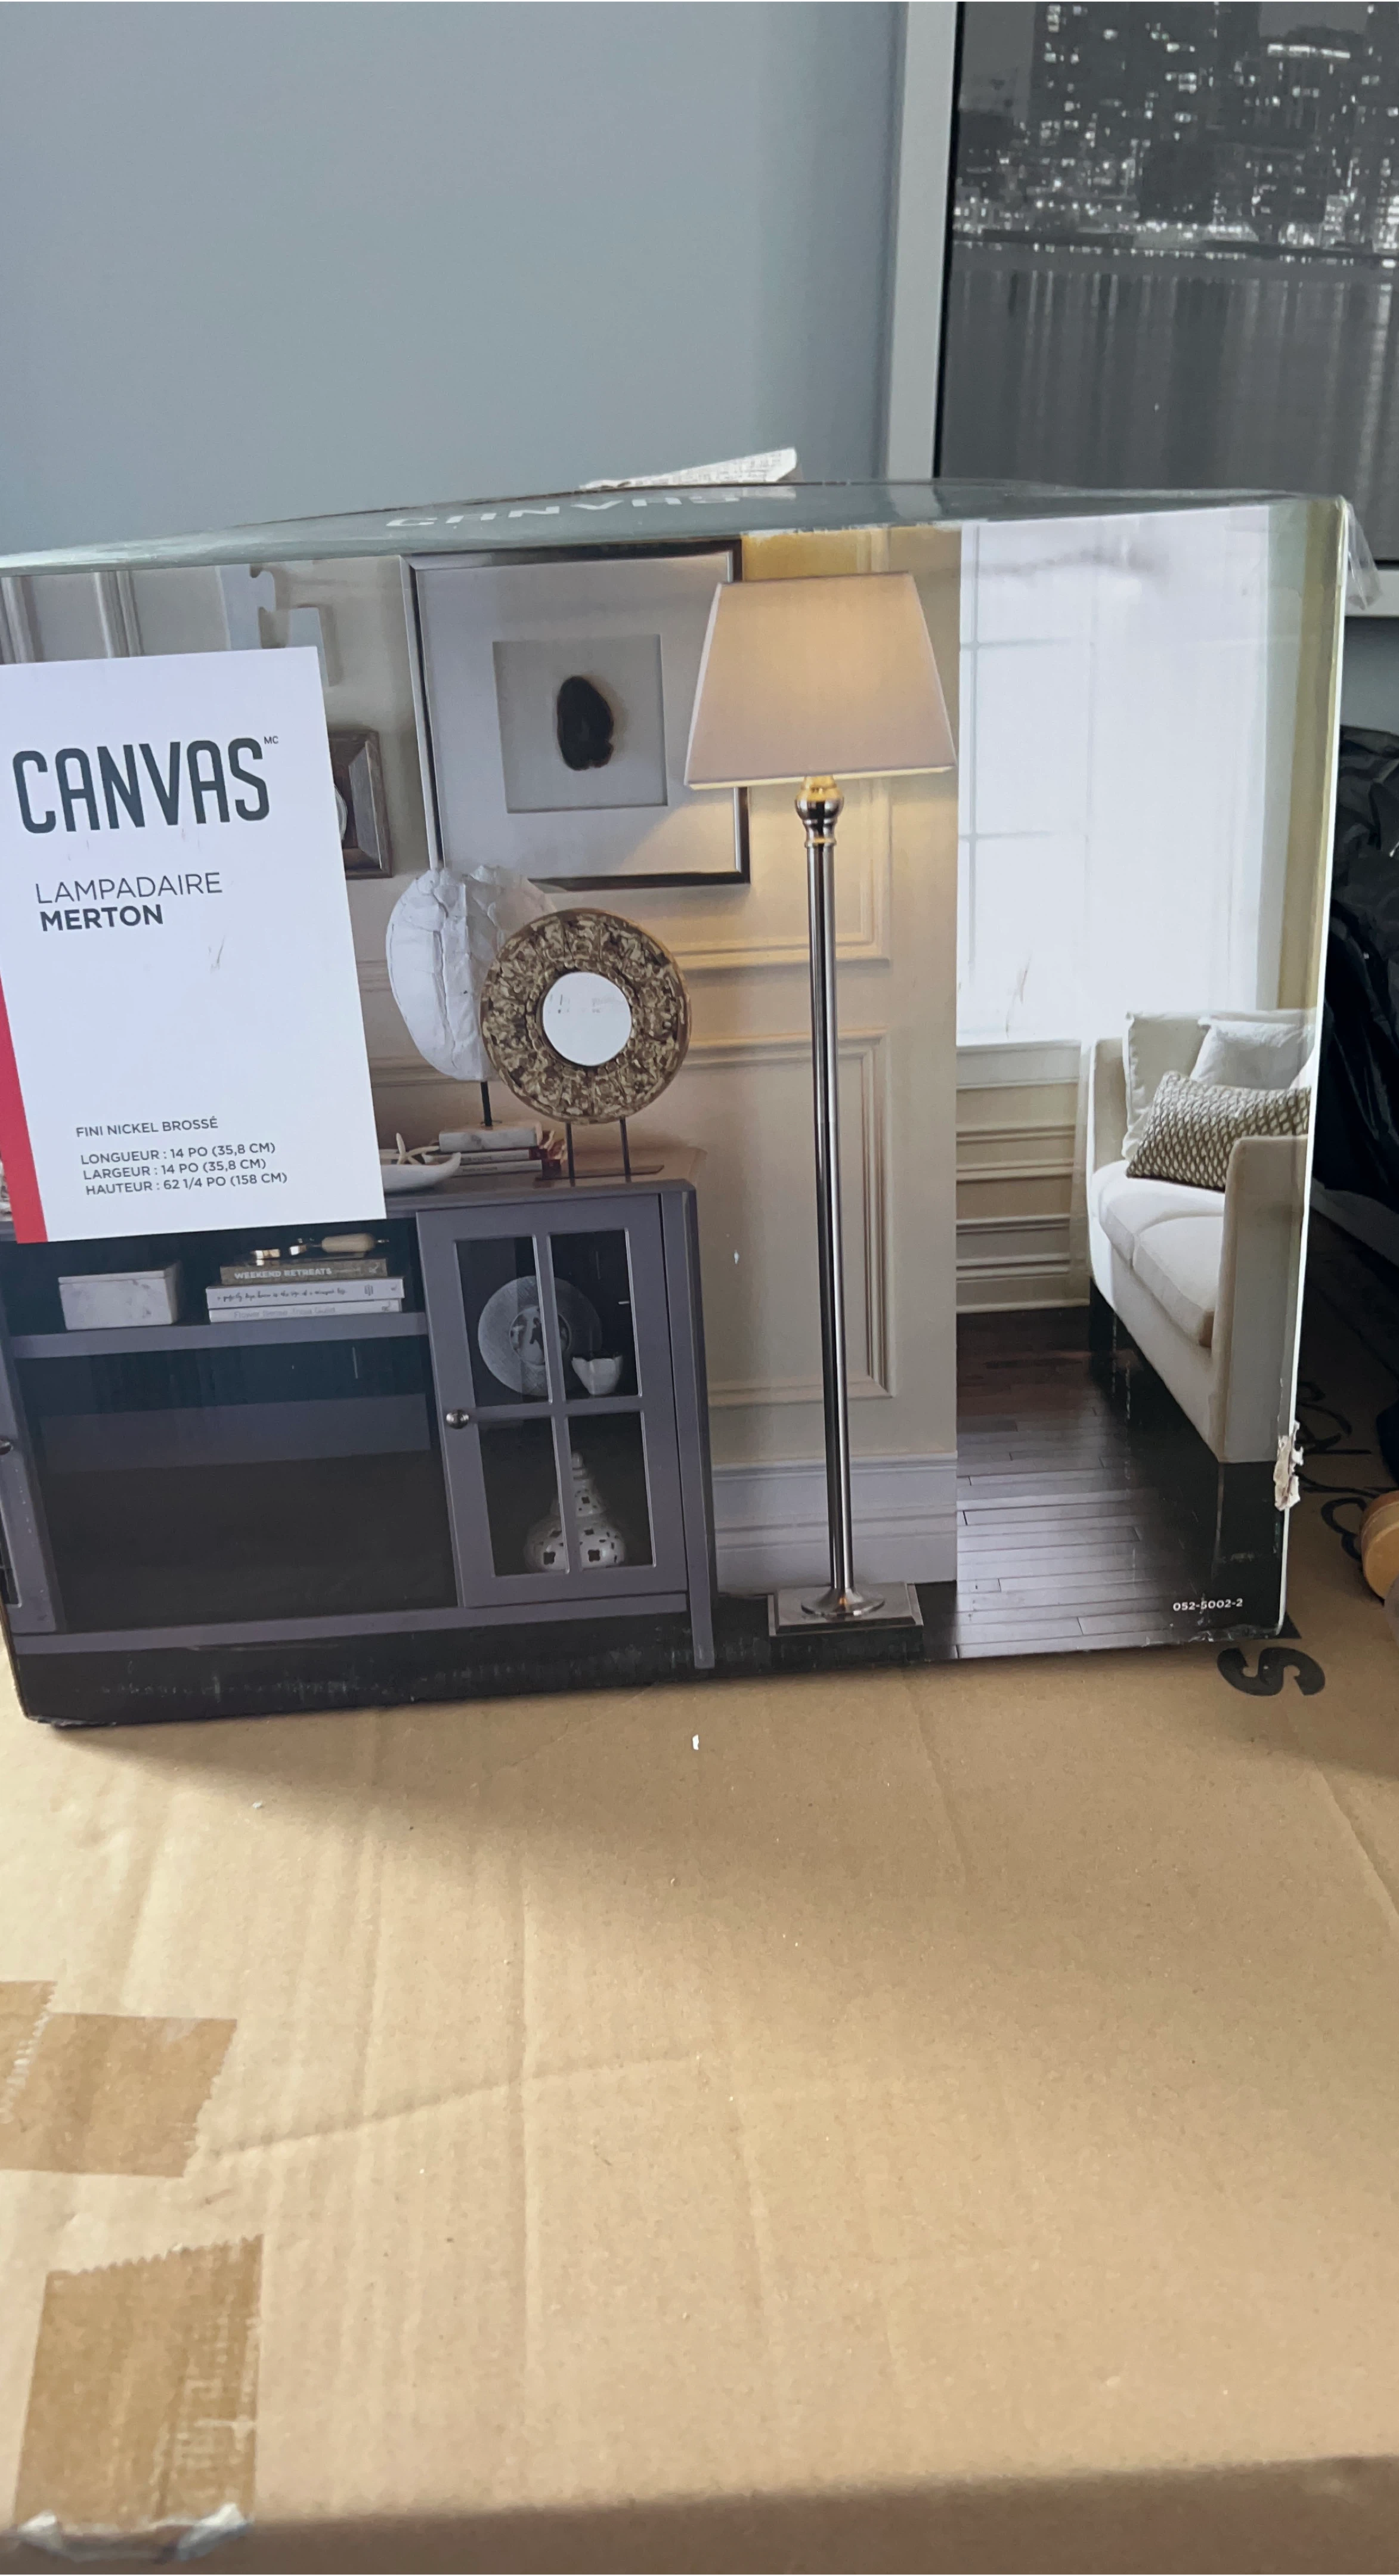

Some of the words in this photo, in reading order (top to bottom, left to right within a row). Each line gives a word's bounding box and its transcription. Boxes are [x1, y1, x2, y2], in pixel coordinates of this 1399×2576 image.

[13, 737, 270, 834] CANVAS
[36, 872, 223, 904] LAMPADAIRE
[40, 904, 163, 932] MERTON
[76, 1125, 103, 1137] FINI
[107, 1122, 159, 1135] NICKEL
[162, 1116, 219, 1132] BROSSÉ
[81, 1150, 160, 1165] LONGUEUR
[170, 1148, 184, 1159] 14
[188, 1146, 208, 1158] PO
[212, 1144, 246, 1157] (35,8
[249, 1142, 276, 1154] CM)
[83, 1166, 151, 1180] LARGEUR
[161, 1165, 175, 1175] 14
[179, 1162, 199, 1174] PO
[203, 1160, 237, 1174] (35,8
[240, 1158, 267, 1170] CM)
[86, 1181, 153, 1196] HAUTEUR
[163, 1179, 181, 1190] 62
[182, 1177, 203, 1190] 1/4
[206, 1176, 226, 1187] PO
[230, 1174, 258, 1187] (158
[261, 1172, 287, 1184] CM)
[234, 1270, 281, 1280] WEEKEND
[284, 1267, 332, 1277] RETREATS
[1172, 1597, 1243, 1612] 052-5002-2
